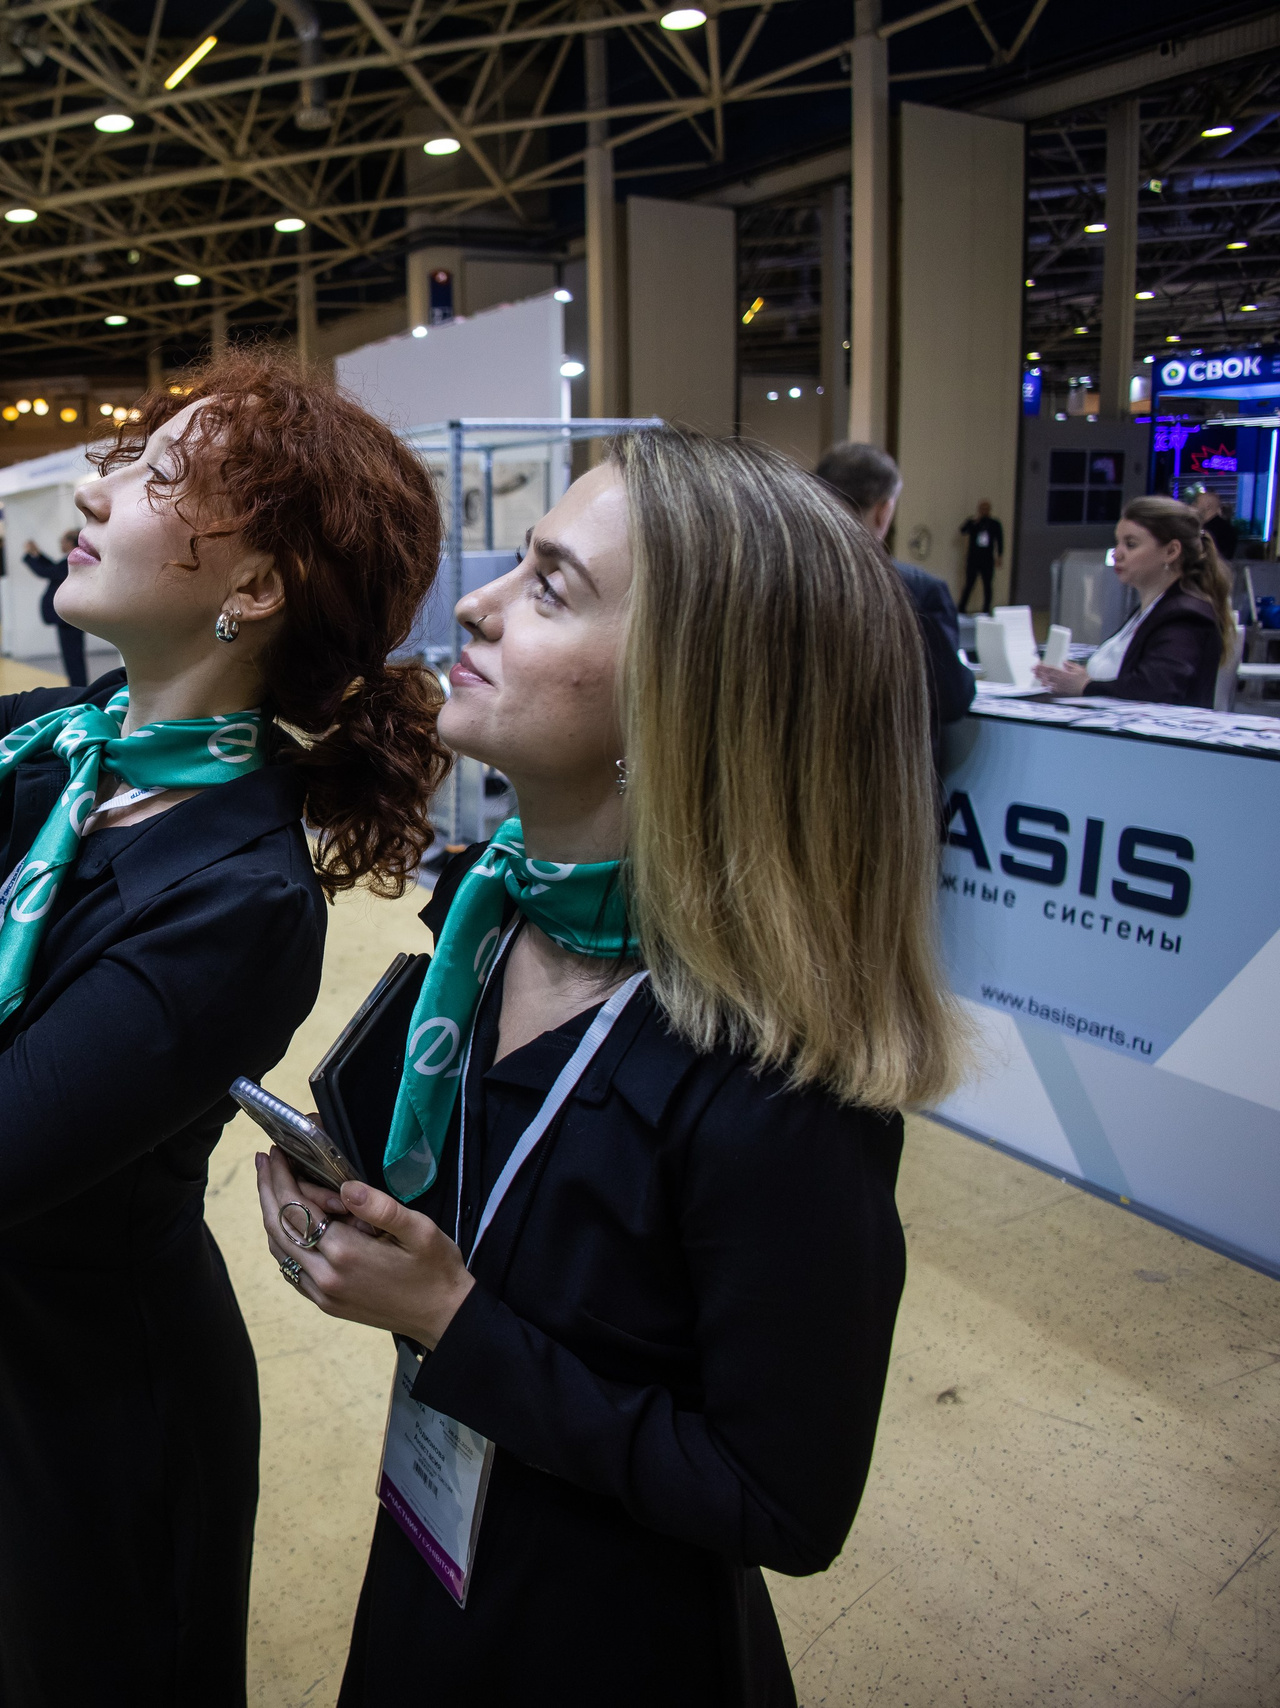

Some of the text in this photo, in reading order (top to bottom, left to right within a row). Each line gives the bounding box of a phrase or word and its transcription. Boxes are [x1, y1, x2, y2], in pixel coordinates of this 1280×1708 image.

[939, 789, 1195, 919] ASIS
[939, 873, 1183, 955] жные системы
[980, 983, 1154, 1056] www.basisparts.ru
